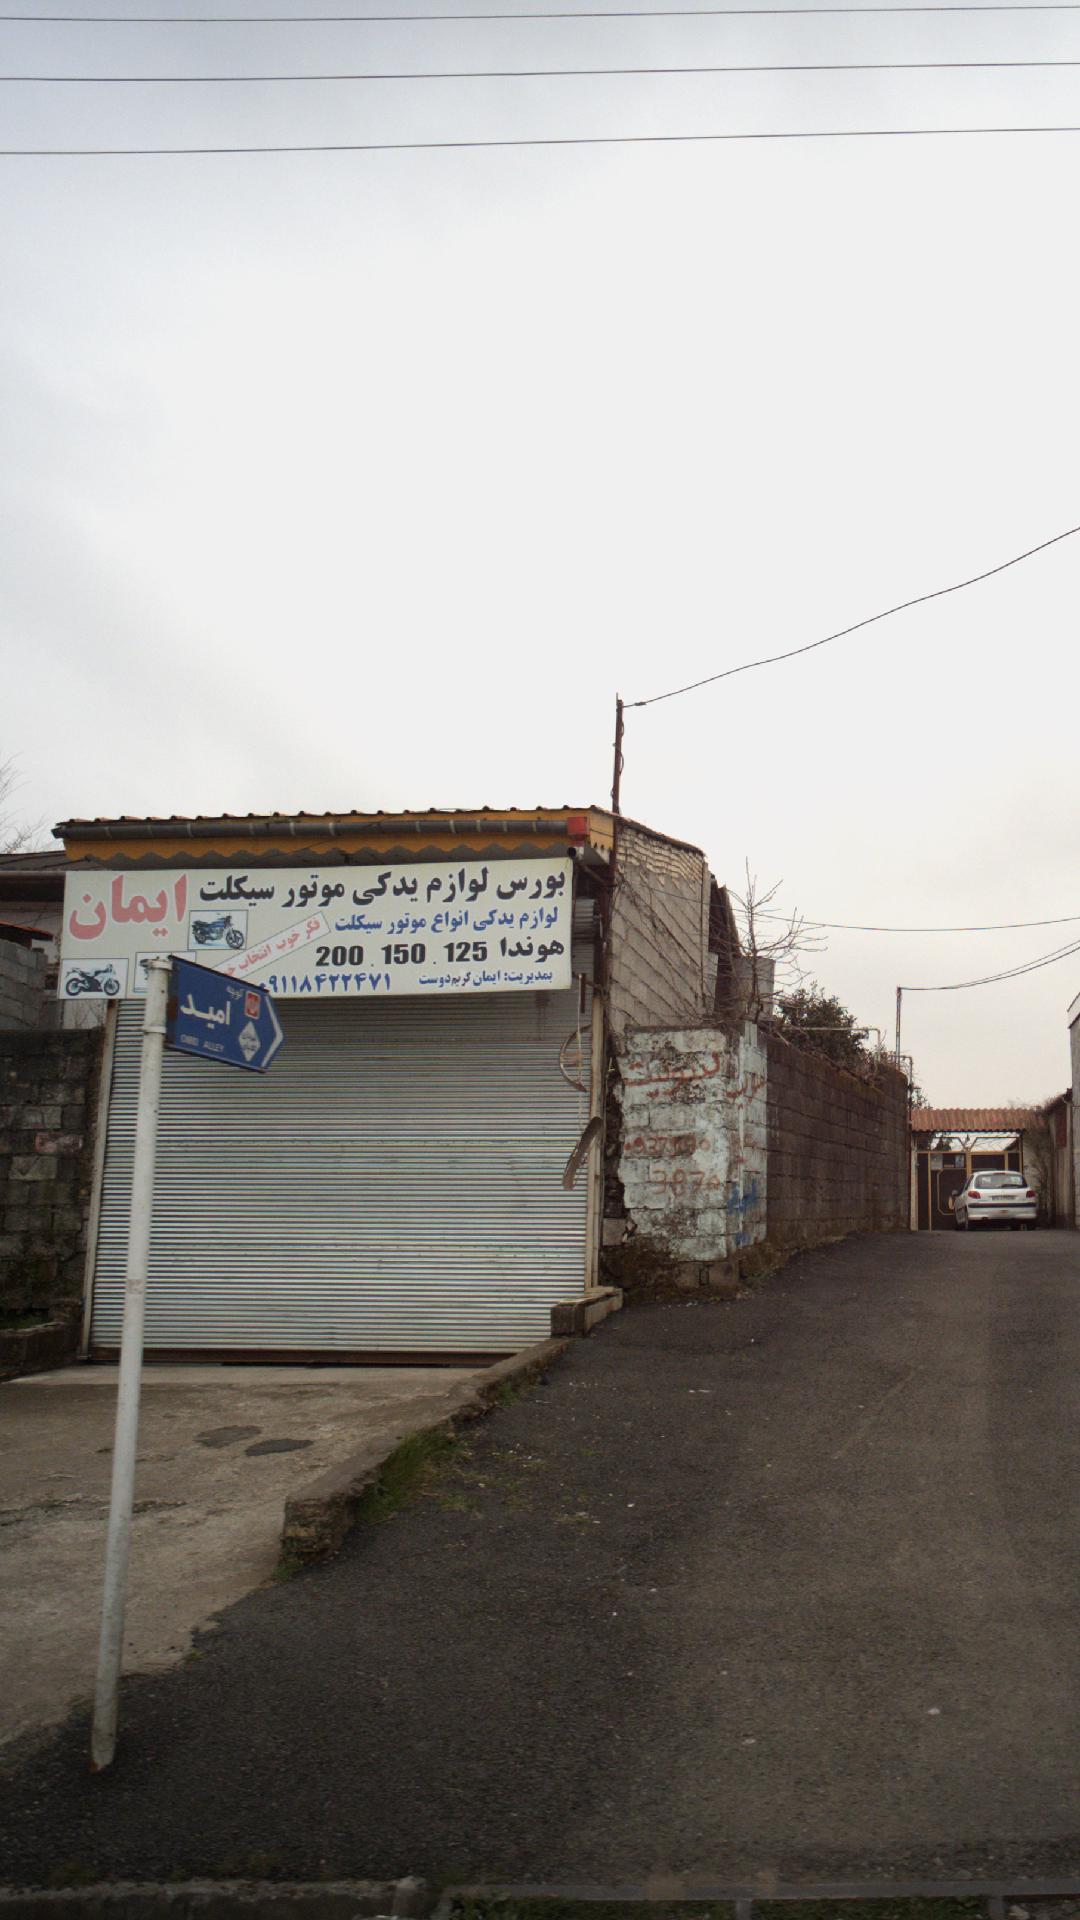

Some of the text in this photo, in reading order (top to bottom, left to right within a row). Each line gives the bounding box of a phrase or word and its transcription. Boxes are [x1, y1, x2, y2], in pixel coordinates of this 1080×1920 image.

[199, 866, 566, 907] بورس لوازم یدکی موتور سیکلت
[69, 873, 188, 940] ایمان
[335, 906, 559, 934] لوازم یدکی انواع موتور سیکلت
[315, 935, 565, 967] هوندا 125 150 200
[472, 970, 501, 987] ایمان
[180, 993, 231, 1030] امید
